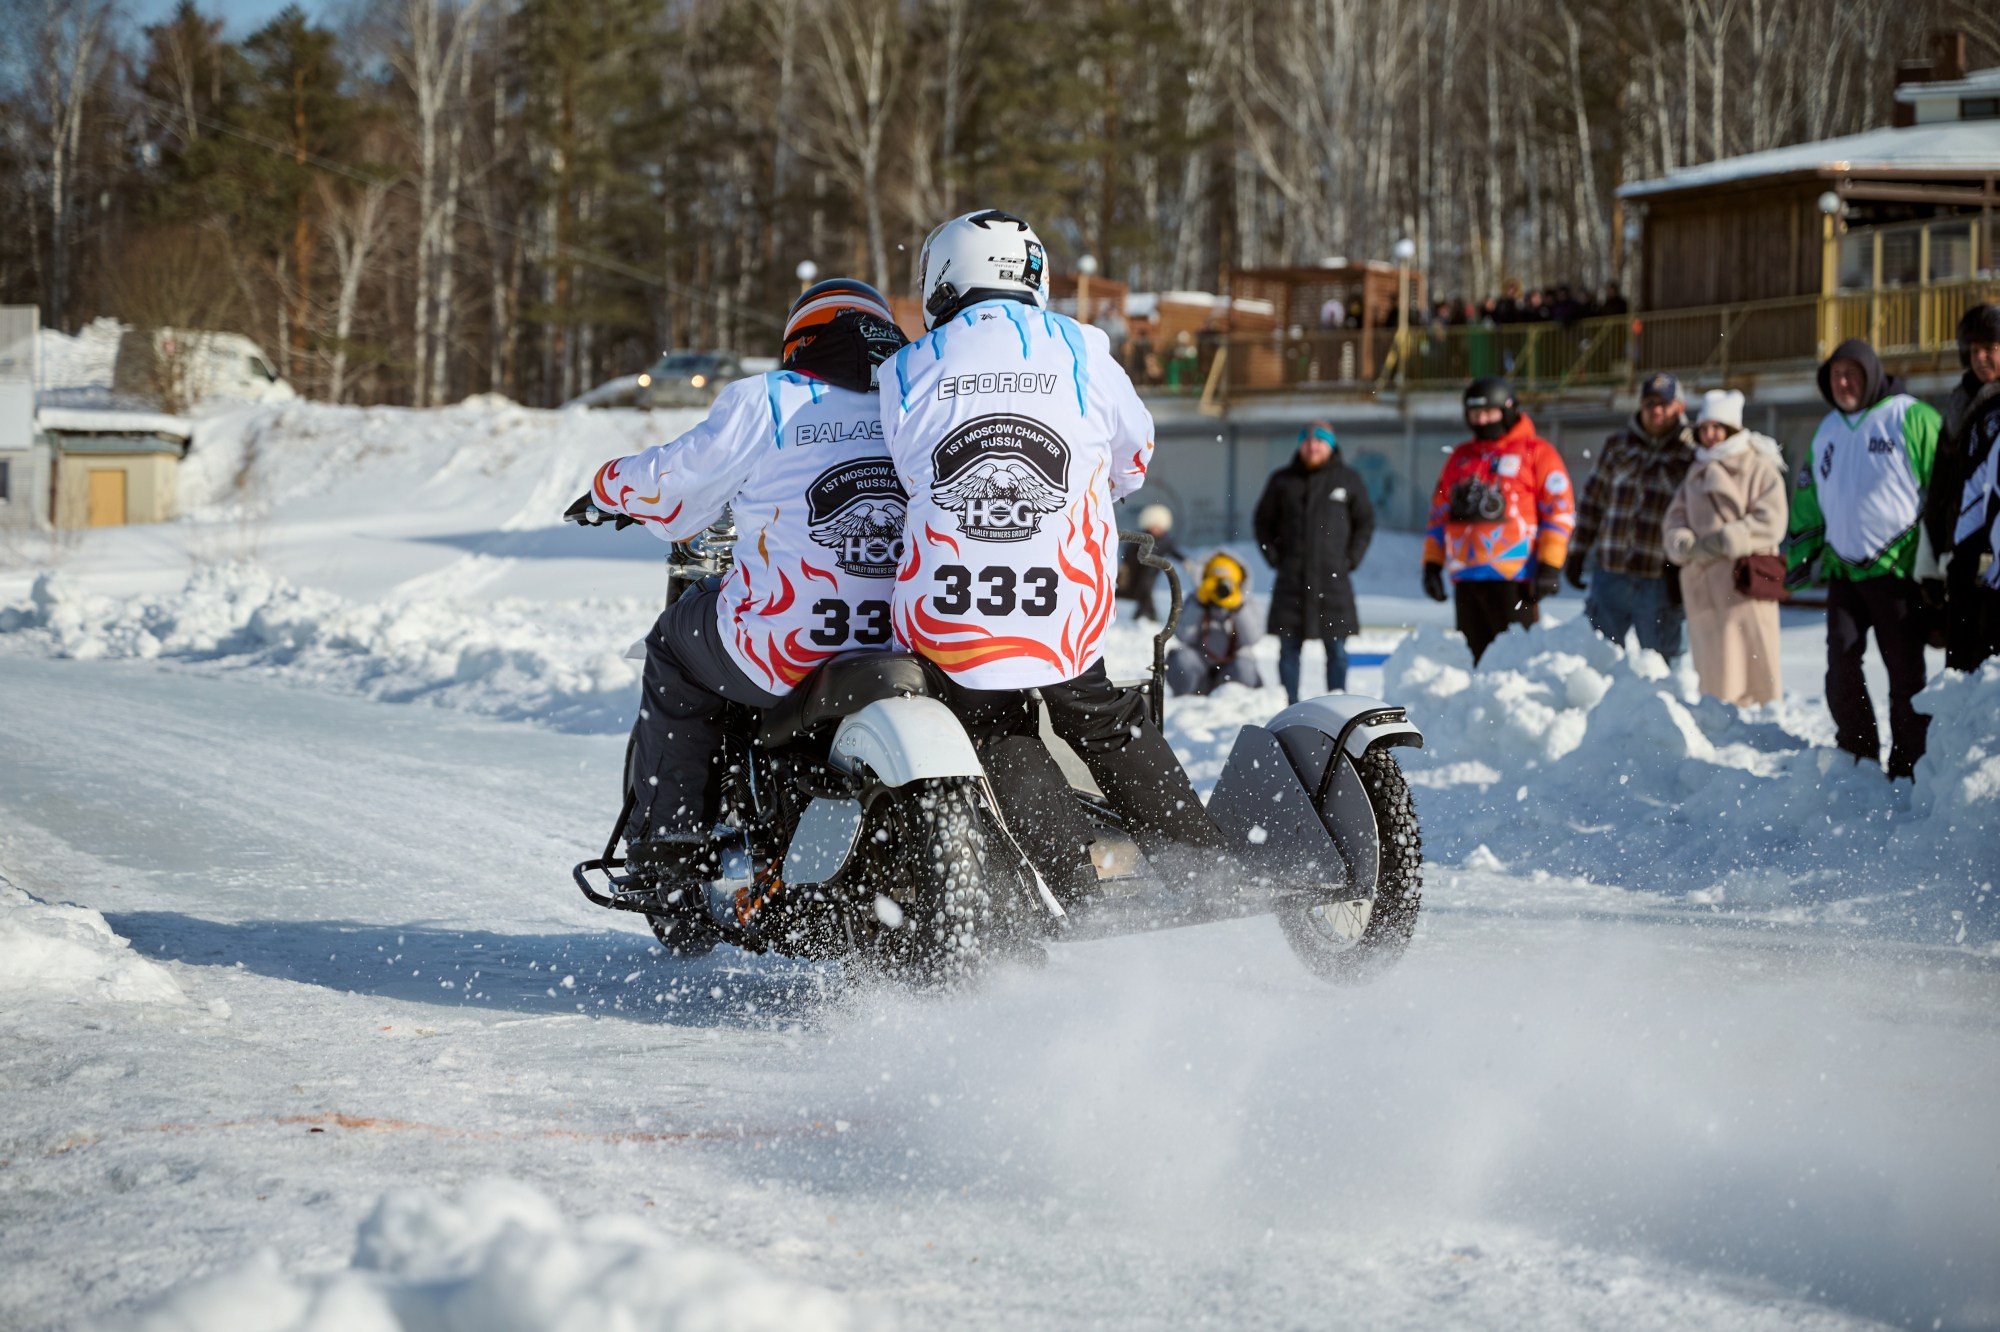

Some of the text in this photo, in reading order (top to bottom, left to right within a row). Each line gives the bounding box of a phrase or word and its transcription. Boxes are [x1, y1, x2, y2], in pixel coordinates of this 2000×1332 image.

[988, 256, 1025, 264] LS2
[938, 372, 1057, 401] EGOROV
[796, 420, 884, 446] BALAS
[945, 424, 1060, 458] 1ST MOSCOW CHAPTER
[981, 437, 1022, 449] RUSSIA
[821, 477, 840, 494] 1ST
[840, 466, 888, 484] MOSCOW
[855, 478, 898, 490] RUSSIA
[964, 499, 1034, 528] HOG
[970, 528, 1028, 538] HARLEY OWNERS GROUP
[849, 563, 867, 573] HARLEY
[933, 565, 1058, 616] 333
